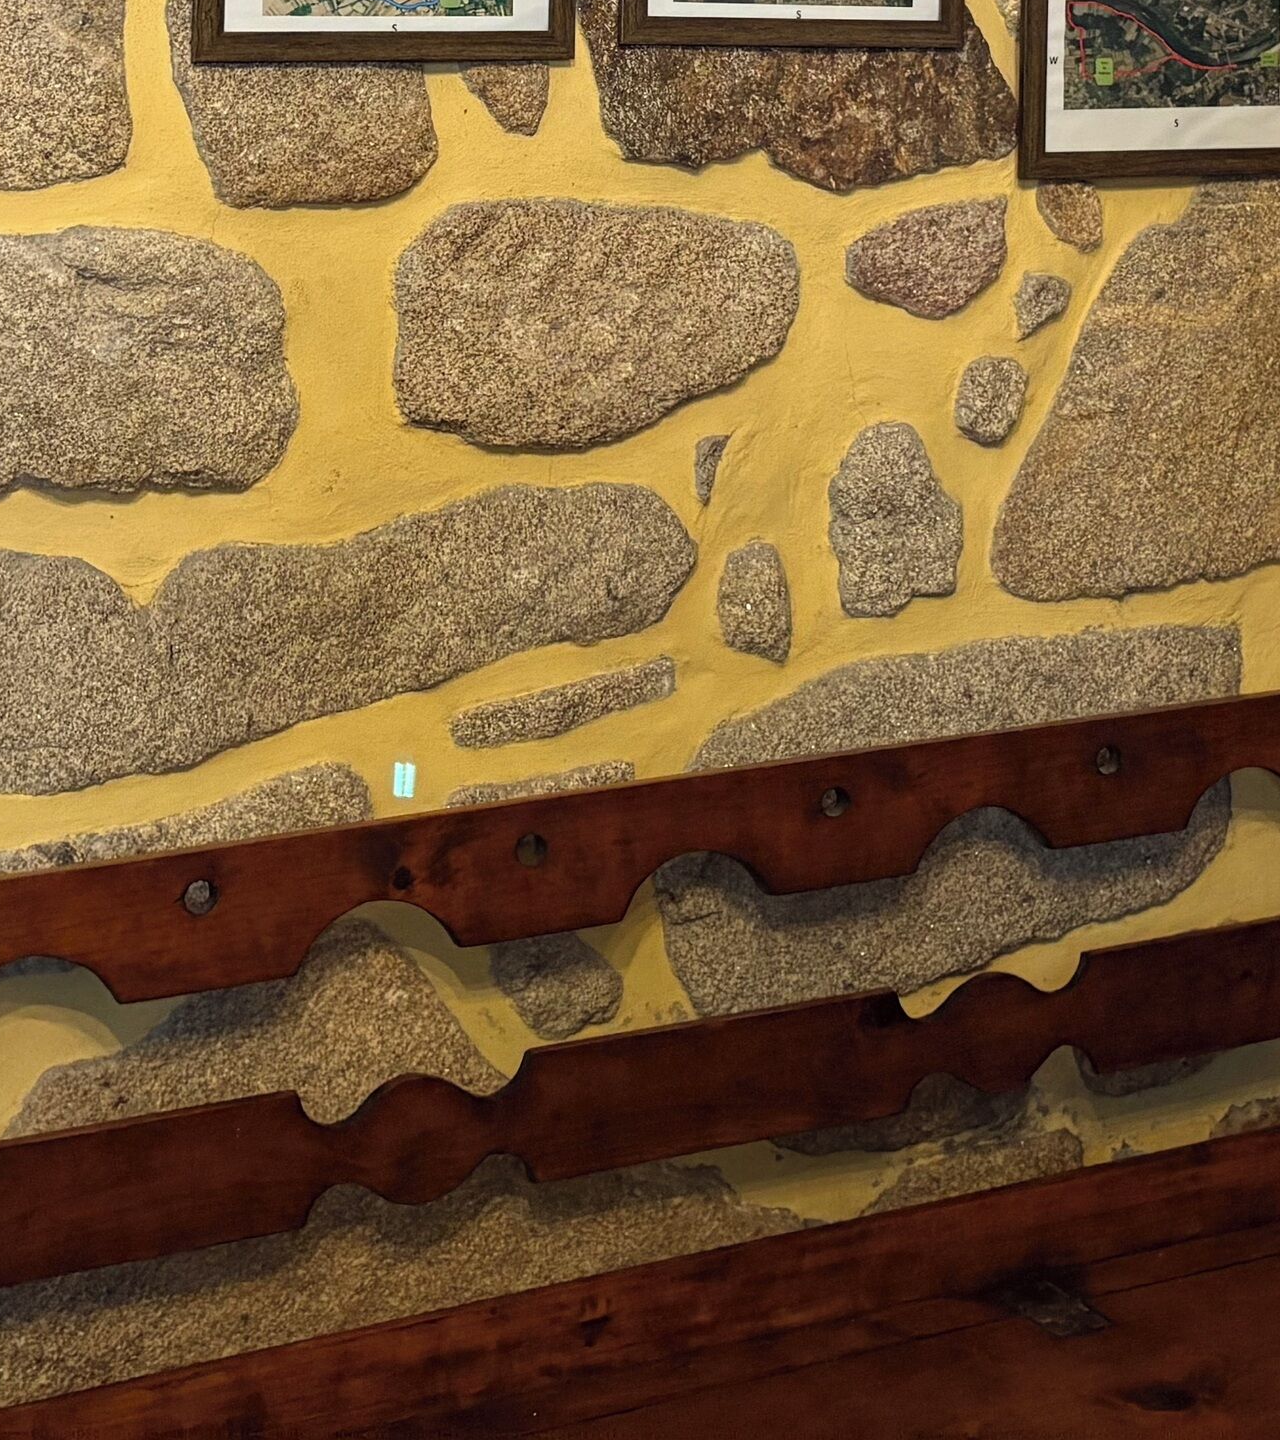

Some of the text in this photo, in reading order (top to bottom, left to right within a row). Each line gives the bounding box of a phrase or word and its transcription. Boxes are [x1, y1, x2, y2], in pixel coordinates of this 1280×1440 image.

[796, 10, 802, 19] S
[1049, 56, 1058, 64] W
[1174, 118, 1179, 128] S
